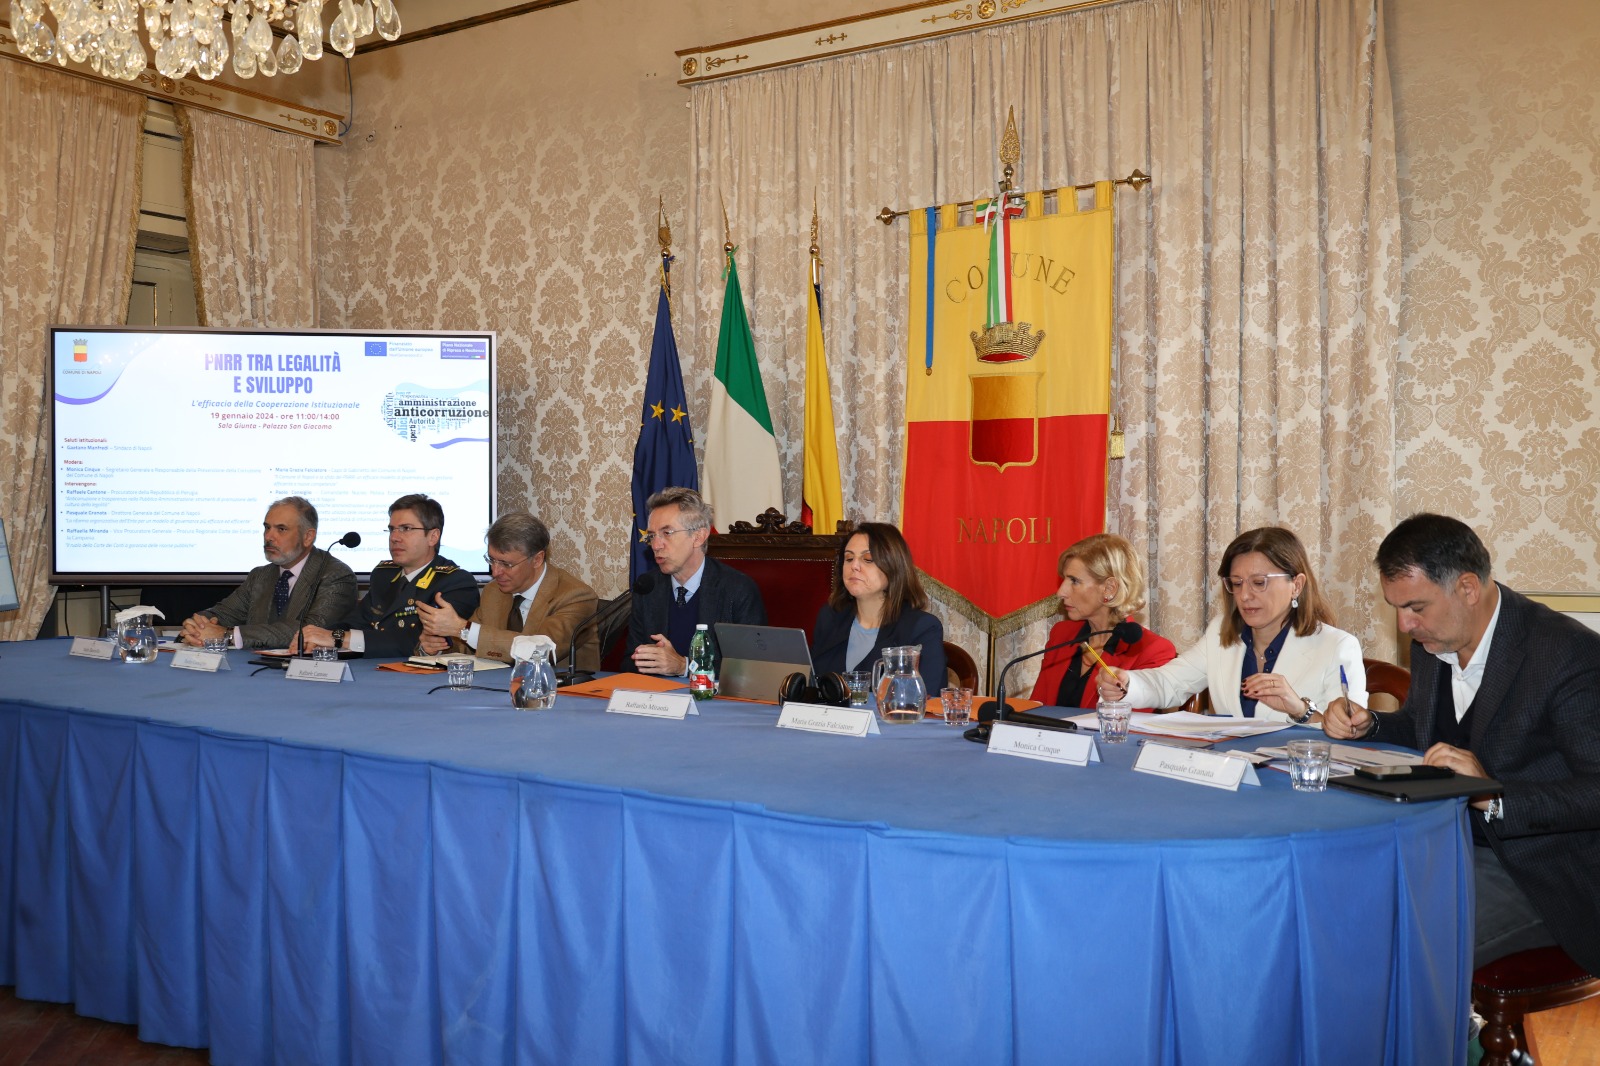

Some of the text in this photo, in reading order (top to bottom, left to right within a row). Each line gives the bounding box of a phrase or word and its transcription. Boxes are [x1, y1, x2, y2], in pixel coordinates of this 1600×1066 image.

[946, 252, 1076, 303] COUNE
[205, 351, 341, 372] PNRR TRA LEGALITÀ
[234, 376, 313, 394] E SVILUPPO
[192, 400, 360, 409] L'efficacia della Cooperazione Istituzionale
[399, 399, 476, 407] amministrazione
[222, 413, 254, 421] gennaio
[296, 413, 340, 421] 11:00/14:00
[394, 407, 489, 417] anticorruzione
[957, 518, 1052, 544] NAPOLI
[808, 720, 826, 728] Grazia
[827, 721, 855, 731] Falciatore
[1014, 741, 1061, 755] Monica Cinque
[1160, 760, 1215, 778] Pasquale Granata
